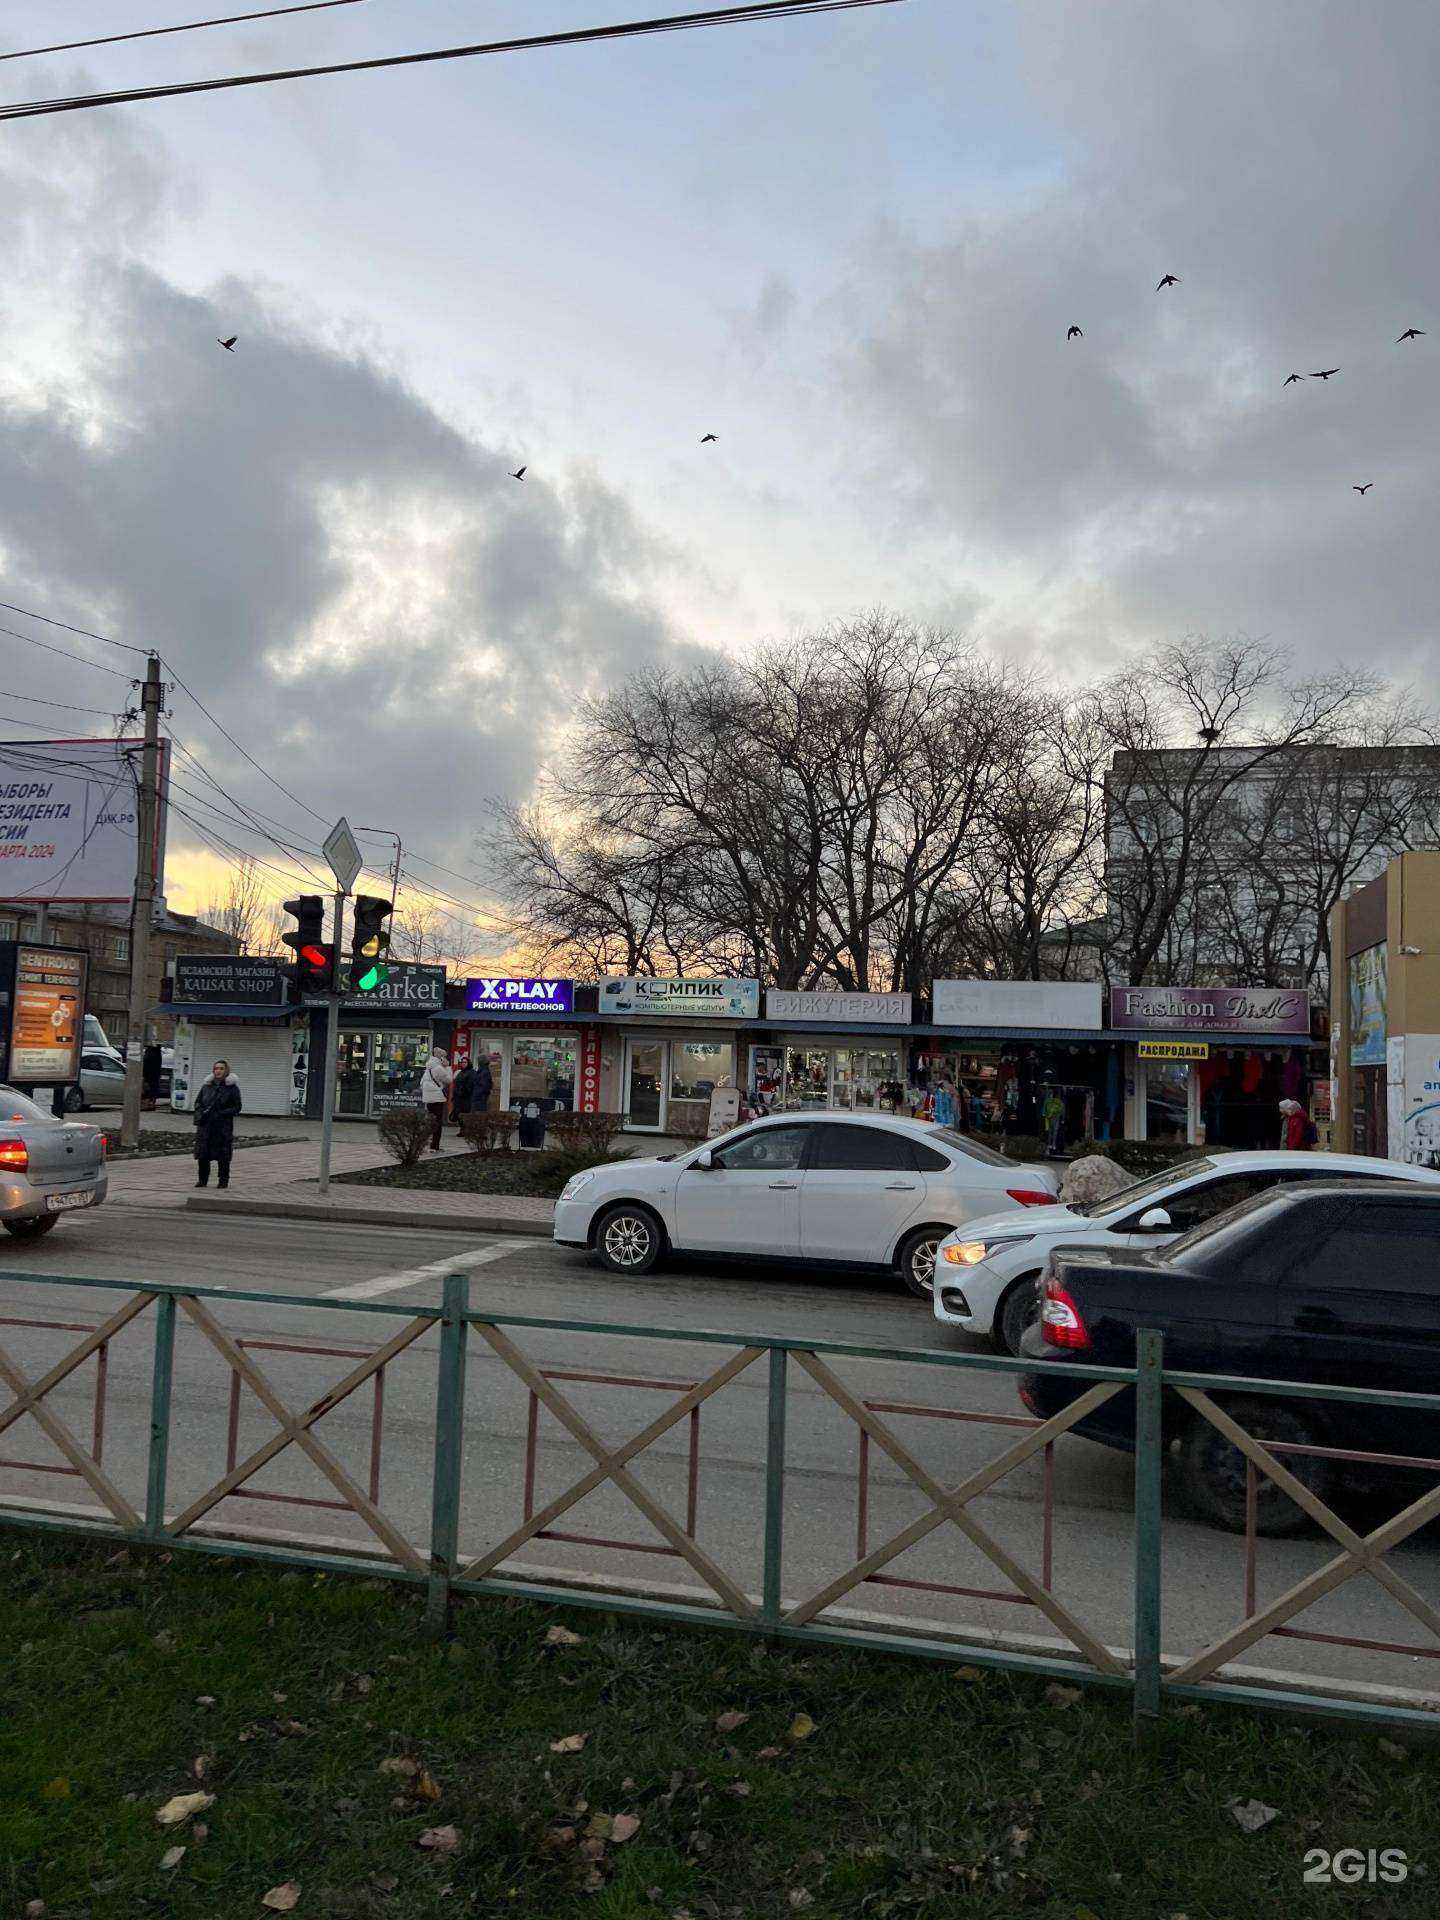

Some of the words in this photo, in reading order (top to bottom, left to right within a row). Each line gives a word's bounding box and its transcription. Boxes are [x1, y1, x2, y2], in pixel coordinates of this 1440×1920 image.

[0, 783, 53, 798] ЫБОРЫ
[0, 804, 71, 820] ЕЗИДЕНТА
[0, 825, 29, 839] СИИ
[0, 845, 27, 859] АРТА
[28, 844, 55, 858] 2024
[180, 965, 233, 976] ИСЛАМСКИЙ
[235, 967, 275, 977] МАГАЗИН
[184, 978, 235, 992] KAUSAR
[238, 979, 274, 992] SHOP
[354, 976, 440, 1000] arket
[304, 999, 331, 1007] ТЕЛЕФО
[472, 1001, 508, 1009] РЕМОНТ
[510, 1002, 565, 1011] ТЕЛЕФОНОВ
[634, 1002, 696, 1012] КОМПЬЮТЕРНЫЕ
[696, 1004, 725, 1013] УСЛУГИ
[774, 996, 905, 1015] БИЖУТЕРИЯ
[1124, 992, 1216, 1018] Fashion
[1139, 1044, 1206, 1058] РАСПРОДАЖА
[584, 1022, 597, 1114] ТЕЛЕФОНО
